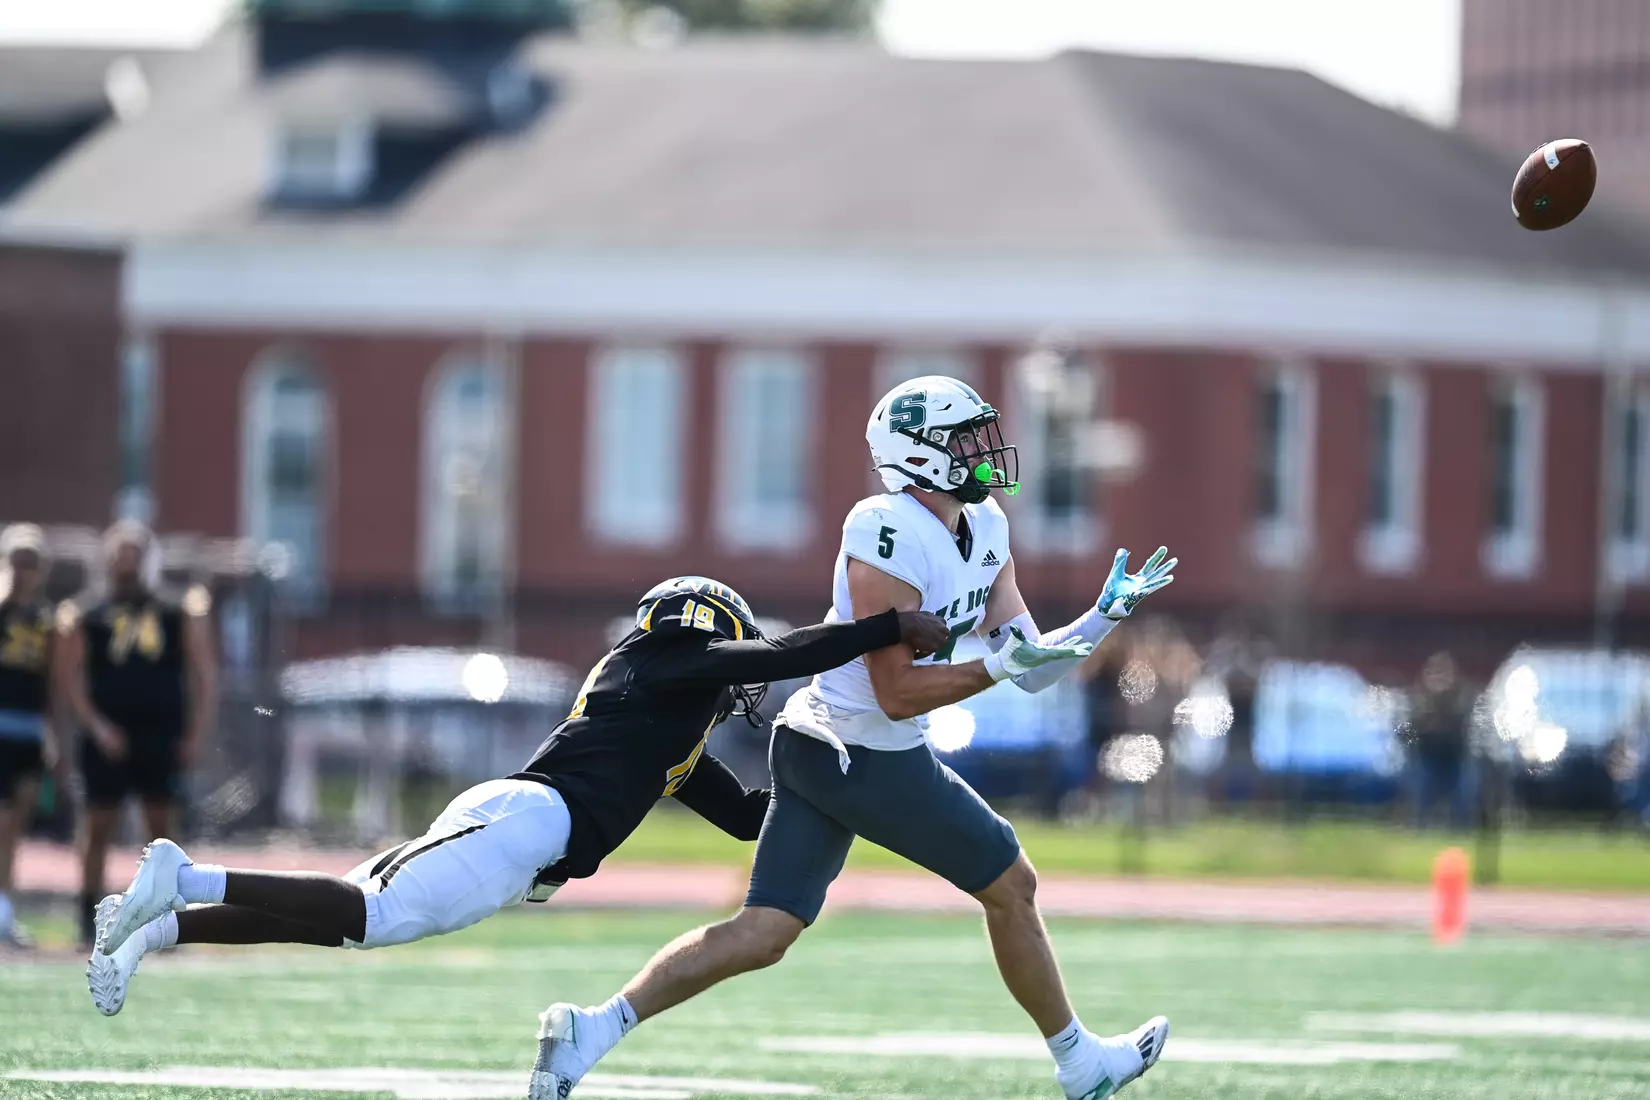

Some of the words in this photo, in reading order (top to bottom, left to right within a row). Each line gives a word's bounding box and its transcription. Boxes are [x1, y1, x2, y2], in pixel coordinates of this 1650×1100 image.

[889, 390, 927, 433] S
[877, 525, 897, 559] 5
[981, 559, 1000, 568] adida
[680, 598, 716, 632] 19
